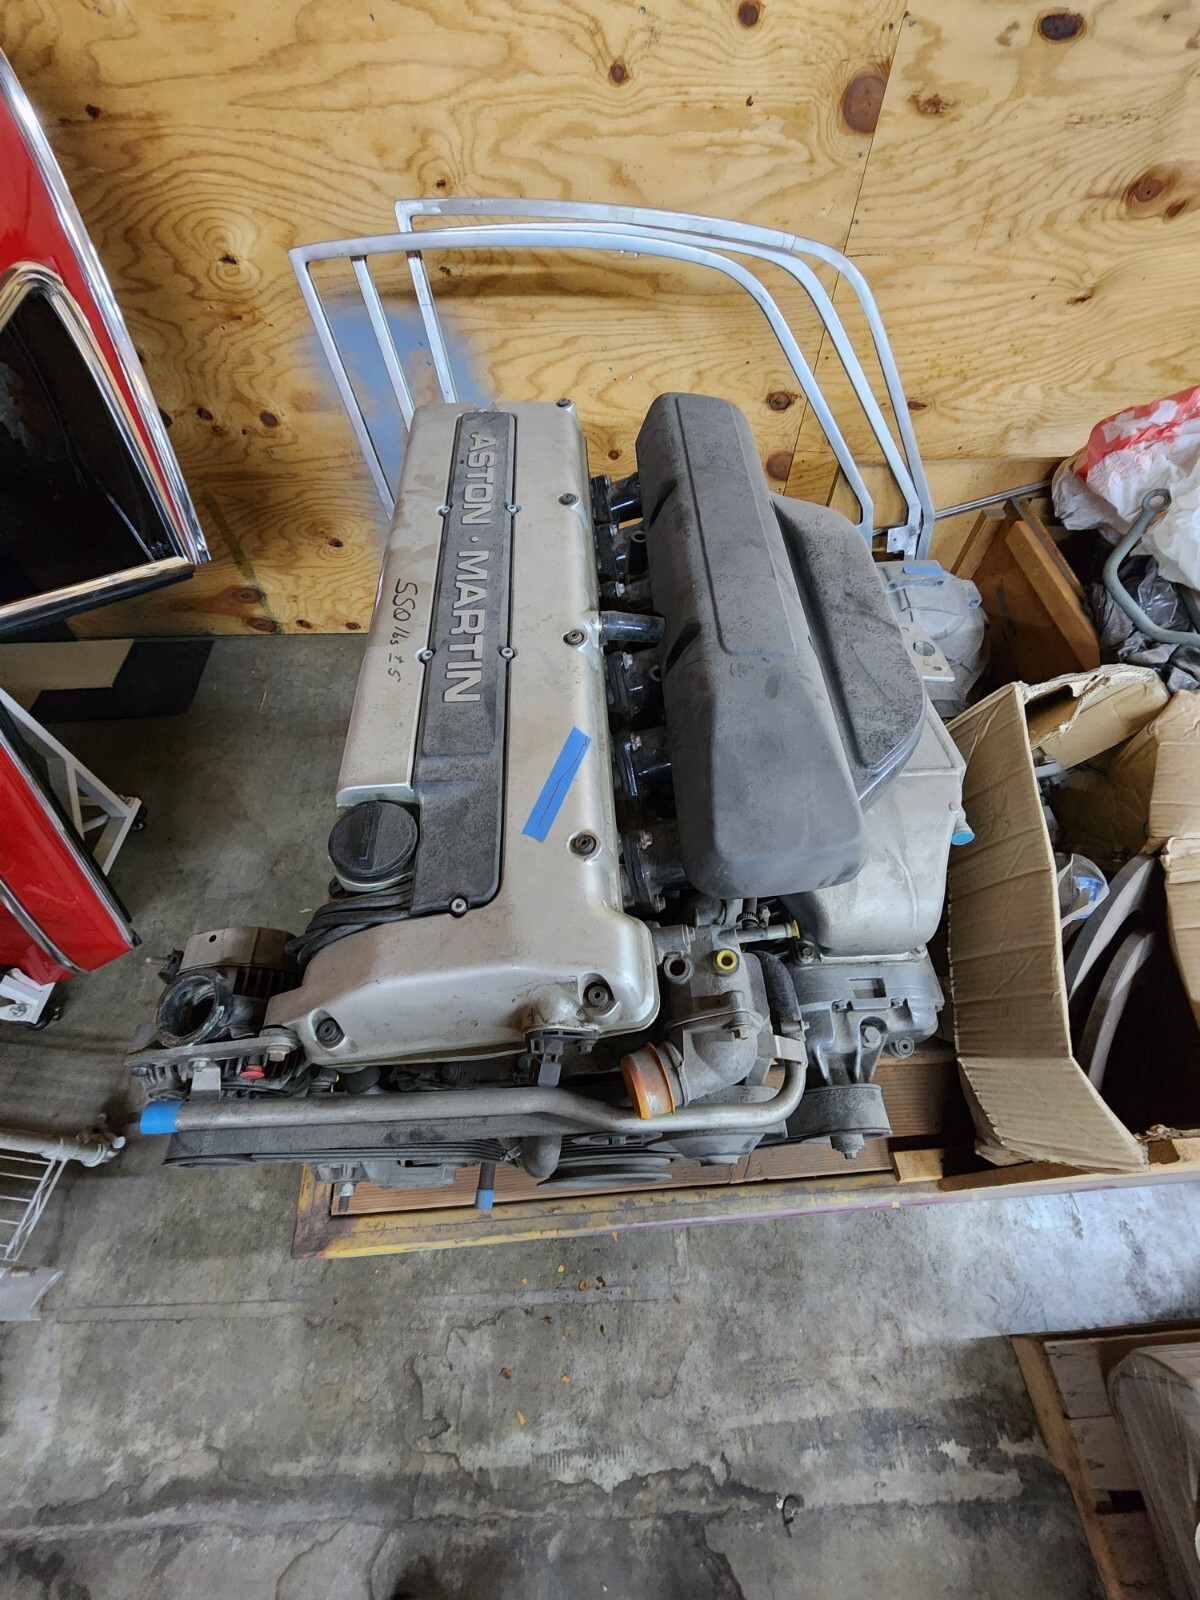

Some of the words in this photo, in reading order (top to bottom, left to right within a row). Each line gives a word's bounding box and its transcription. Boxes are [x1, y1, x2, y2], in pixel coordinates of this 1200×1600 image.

[461, 432, 497, 525] ASTON
[389, 626, 411, 646] lbs
[444, 551, 490, 703] MARTIN
